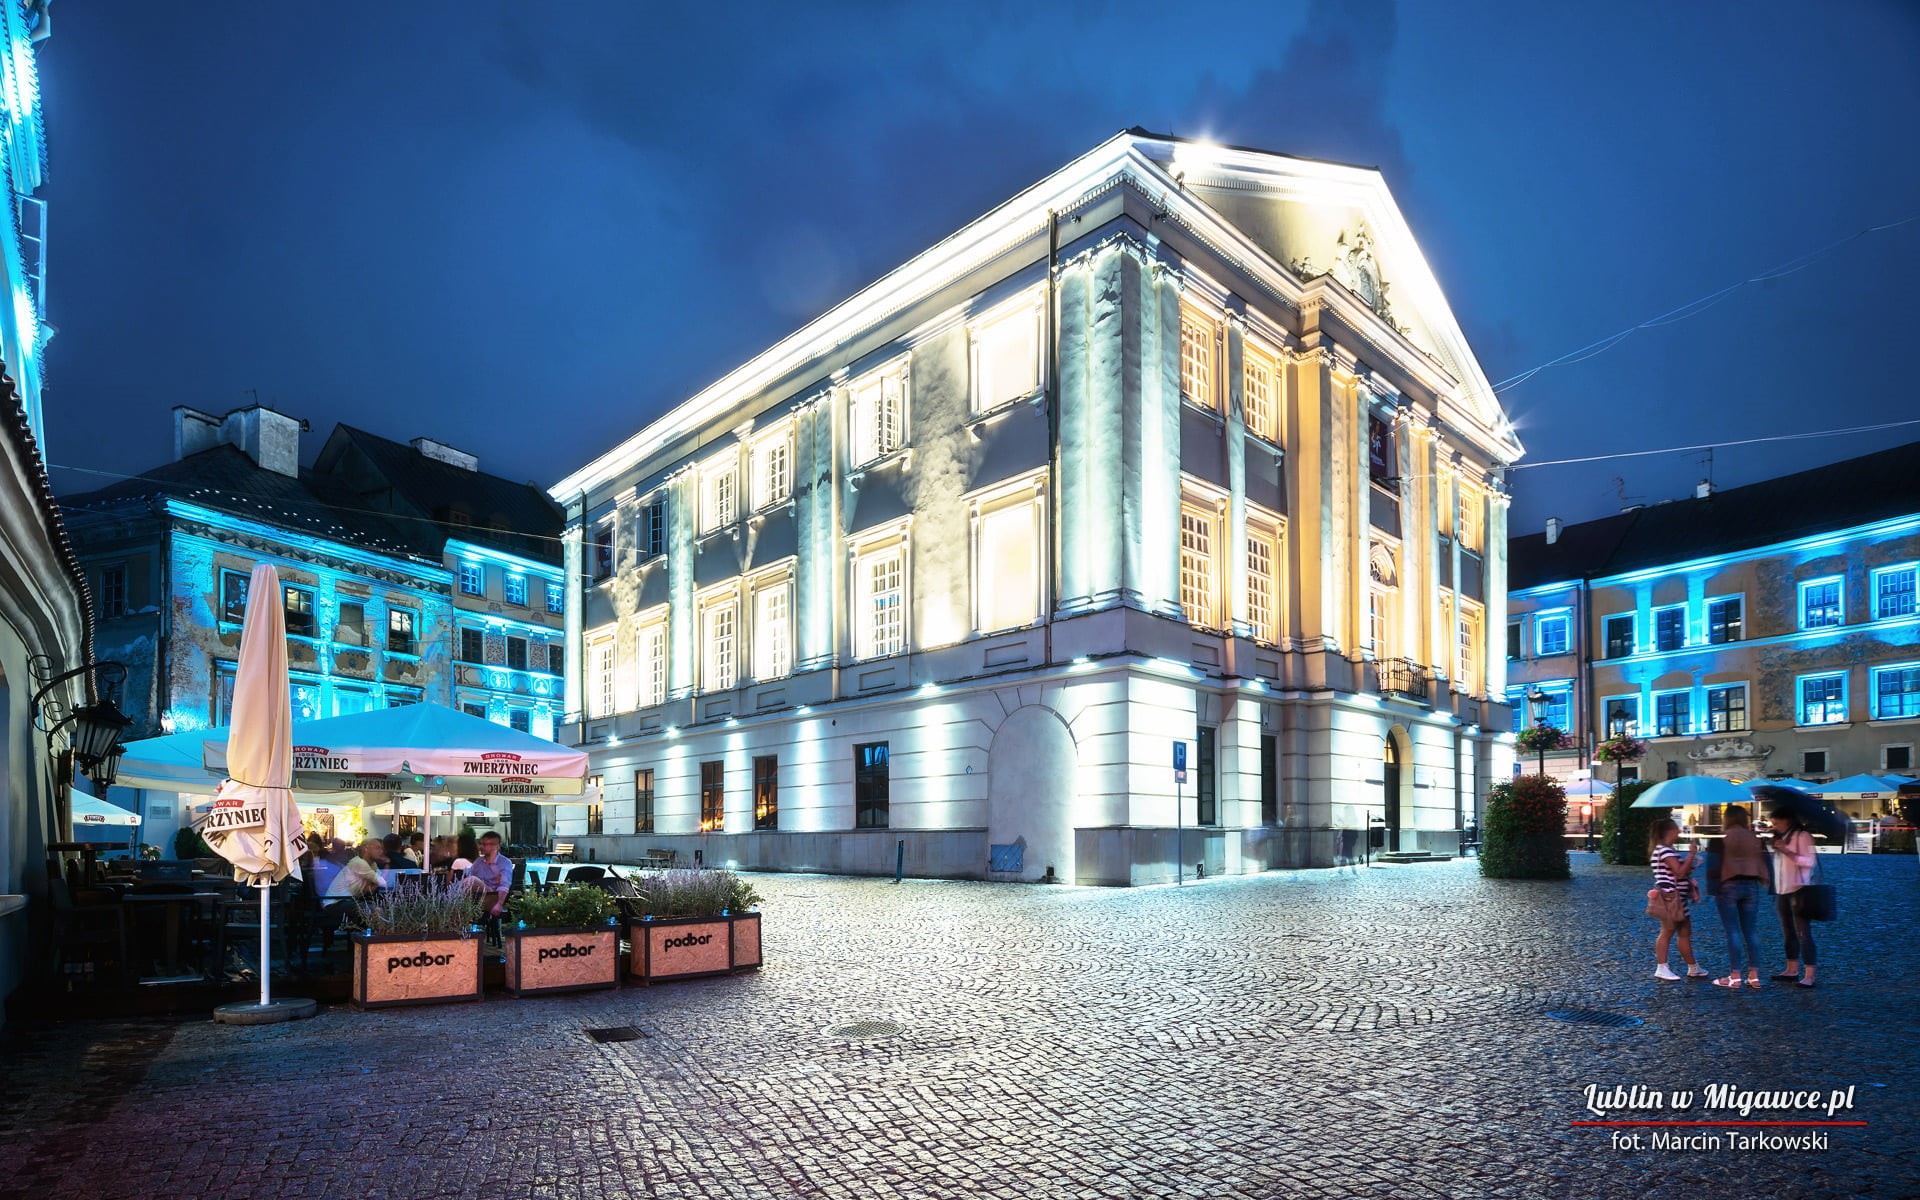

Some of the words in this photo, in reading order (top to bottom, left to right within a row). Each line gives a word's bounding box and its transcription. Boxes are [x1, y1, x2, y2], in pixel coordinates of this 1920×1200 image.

[1176, 743, 1185, 765] P
[463, 762, 539, 775] ZWIERZYNIEC
[664, 932, 713, 953] padbar
[387, 951, 455, 974] padbar
[538, 943, 596, 964] padbar
